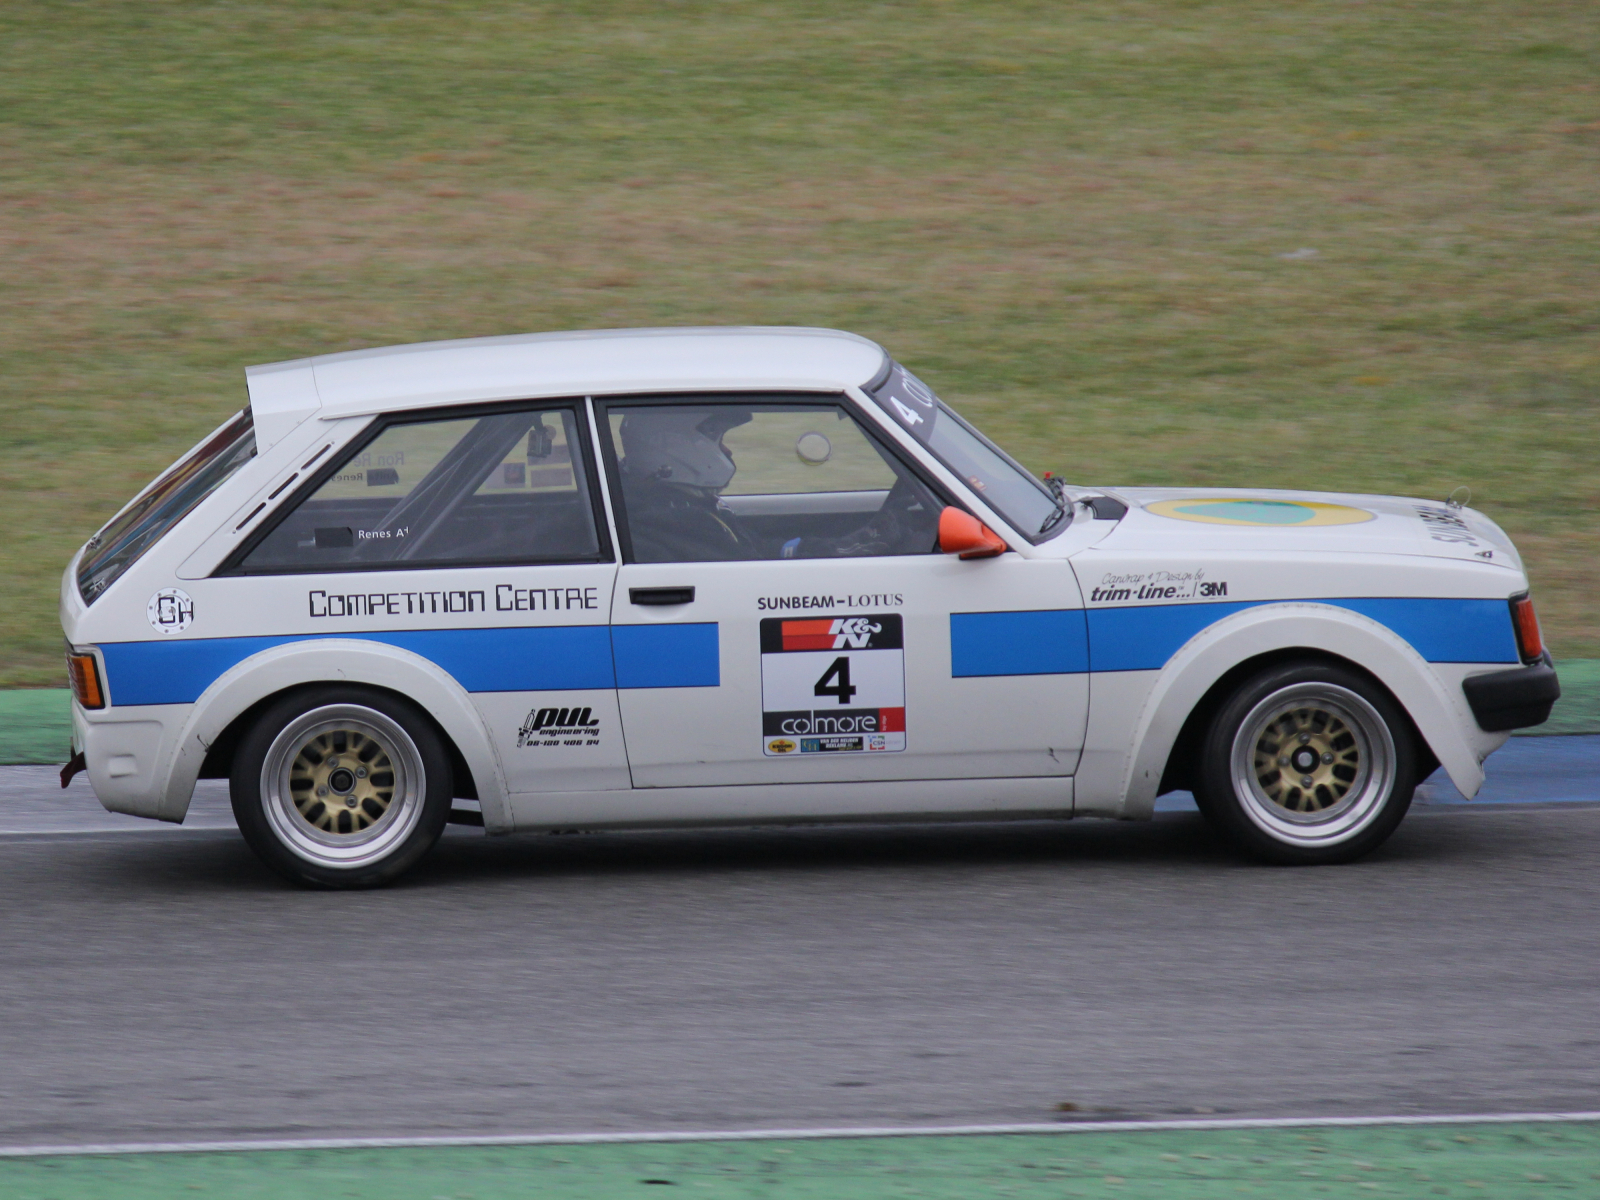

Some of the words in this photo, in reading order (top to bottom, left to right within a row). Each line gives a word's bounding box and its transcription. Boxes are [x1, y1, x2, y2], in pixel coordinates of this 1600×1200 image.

[890, 396, 924, 425] 4
[358, 529, 391, 539] Renes
[1156, 570, 1193, 585] Design
[1194, 567, 1205, 583] by
[1200, 582, 1228, 597] 3M
[814, 656, 857, 704] 4
[781, 710, 876, 734] colmore
[539, 727, 600, 737] engineering
